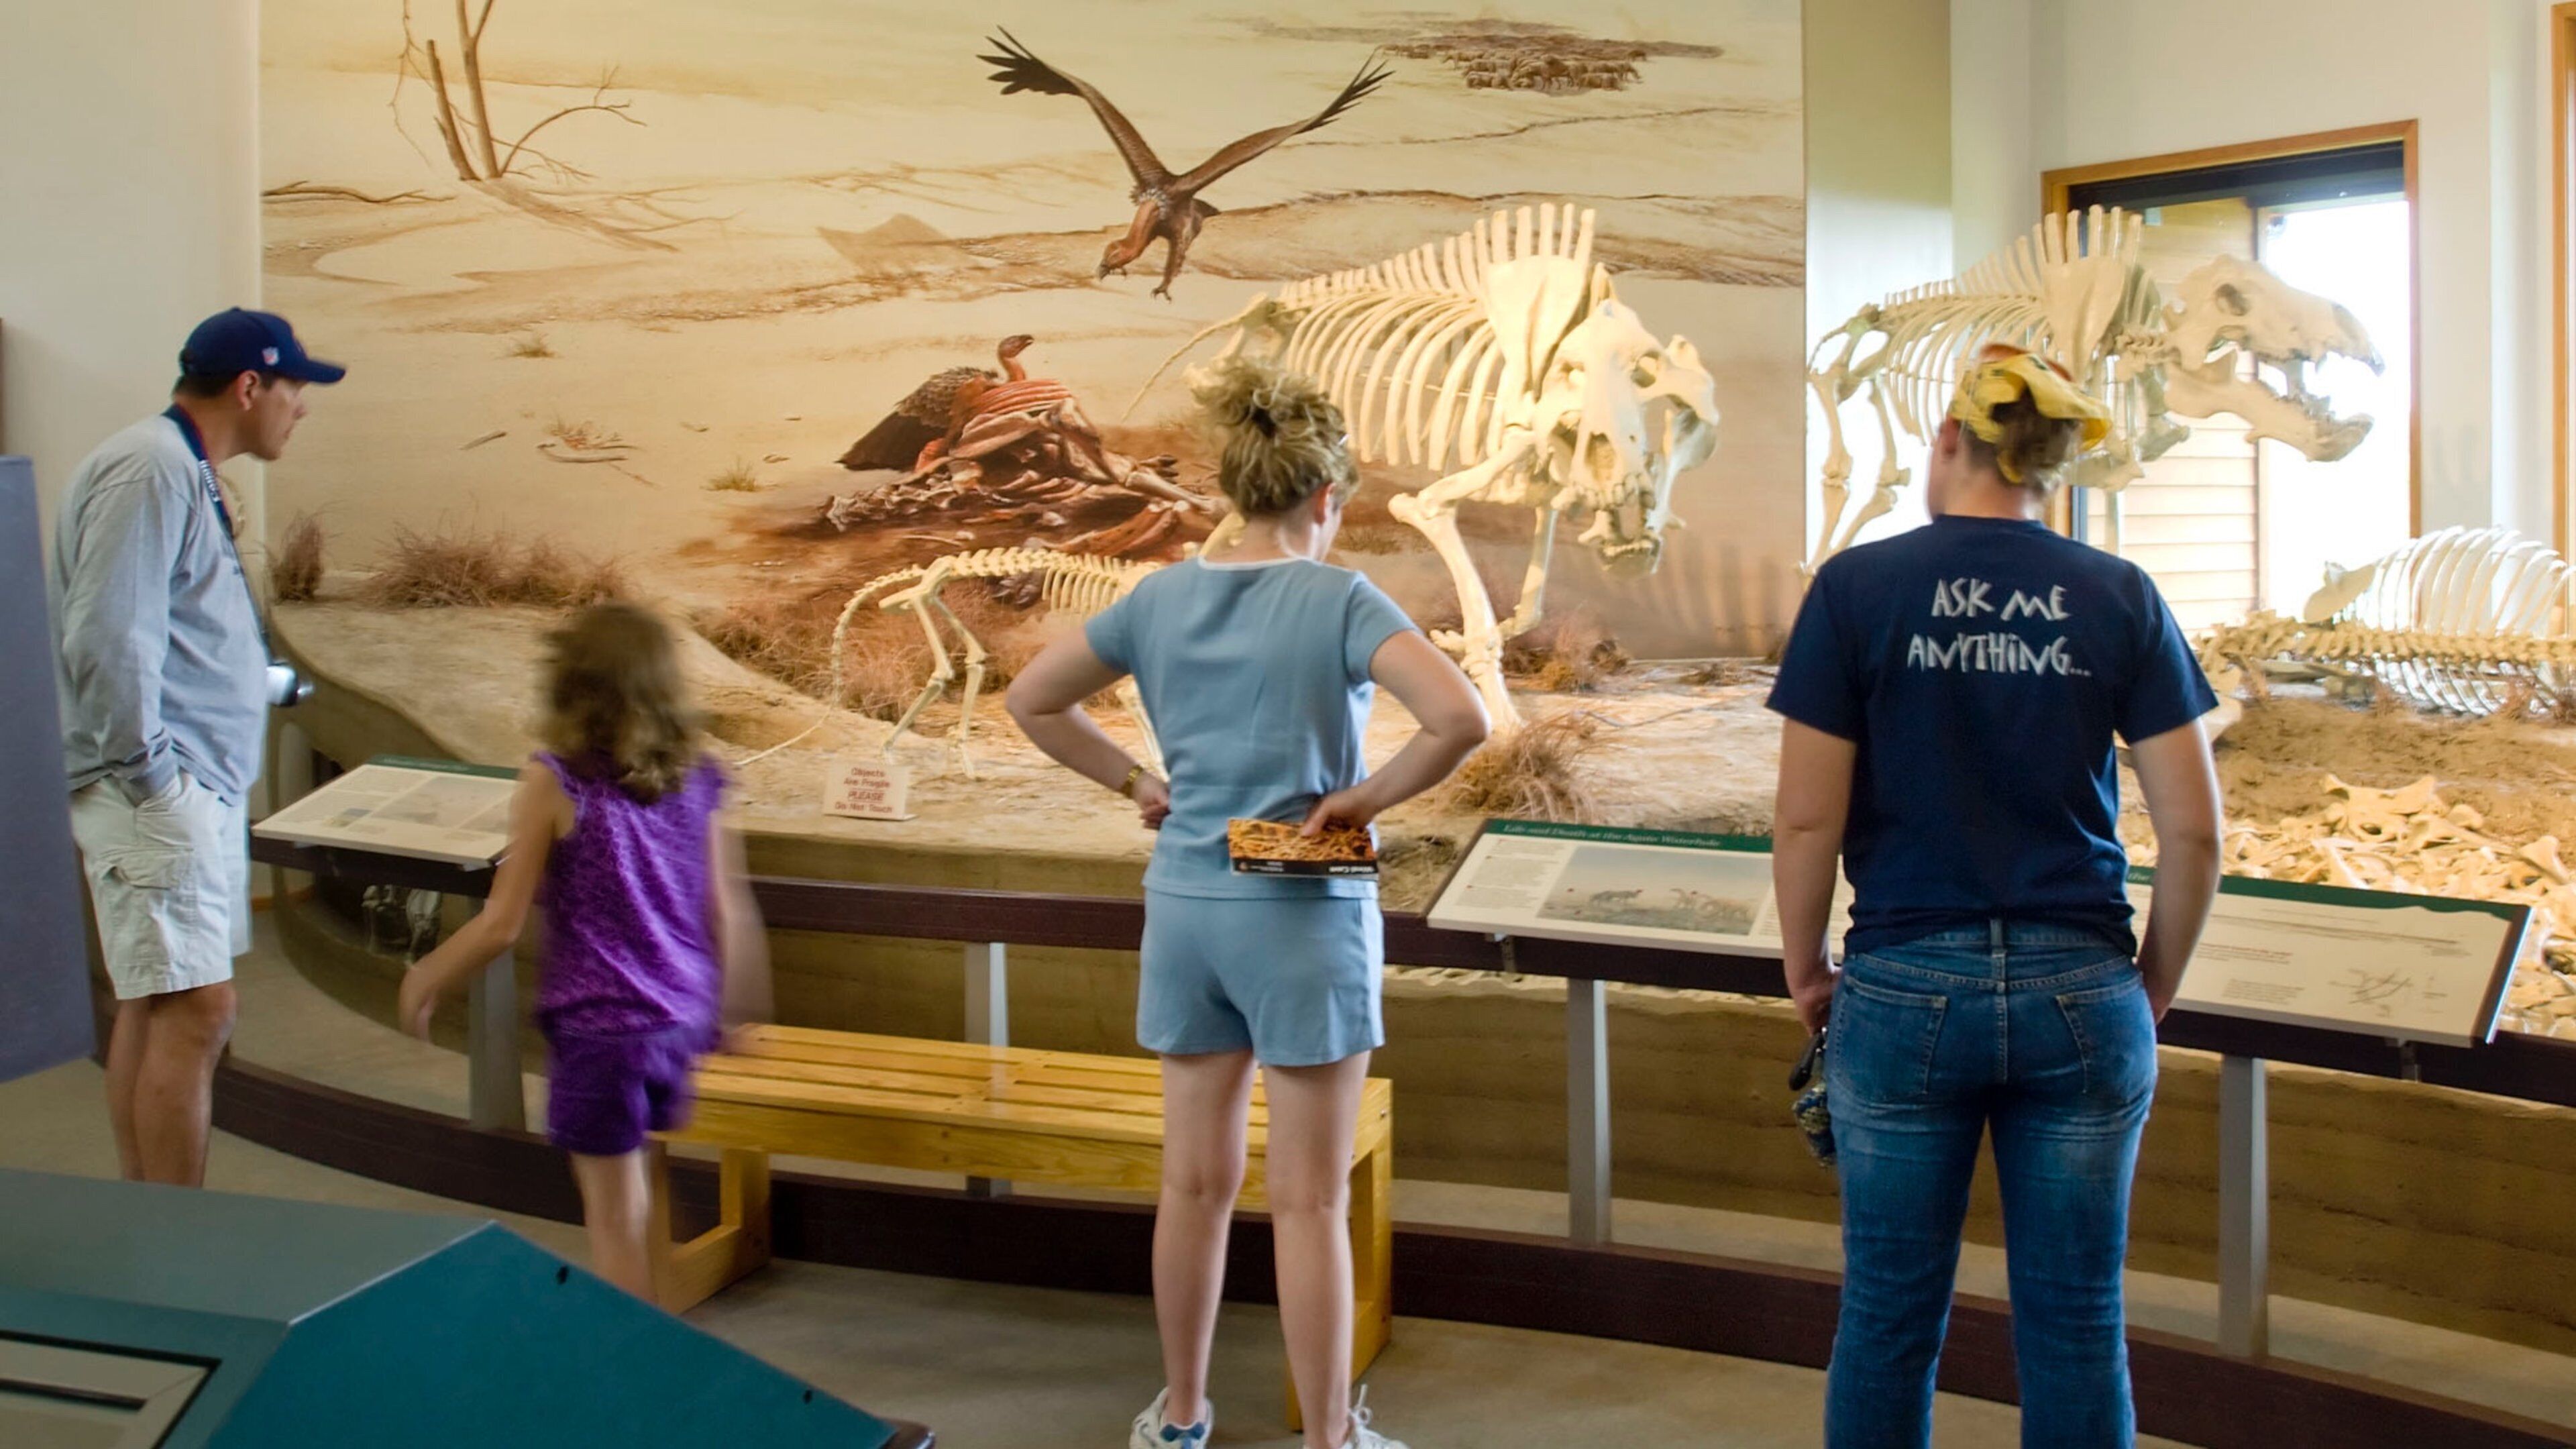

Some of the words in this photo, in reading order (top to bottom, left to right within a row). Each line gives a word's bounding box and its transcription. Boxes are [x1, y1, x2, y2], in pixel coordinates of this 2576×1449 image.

[1931, 578, 1996, 617] ASK
[2000, 584, 2072, 621] ME
[851, 767, 885, 777] Objects
[861, 779, 890, 788] Fragile
[848, 790, 885, 801] PLEASE
[835, 802, 847, 810] Do
[869, 804, 893, 813] Touch
